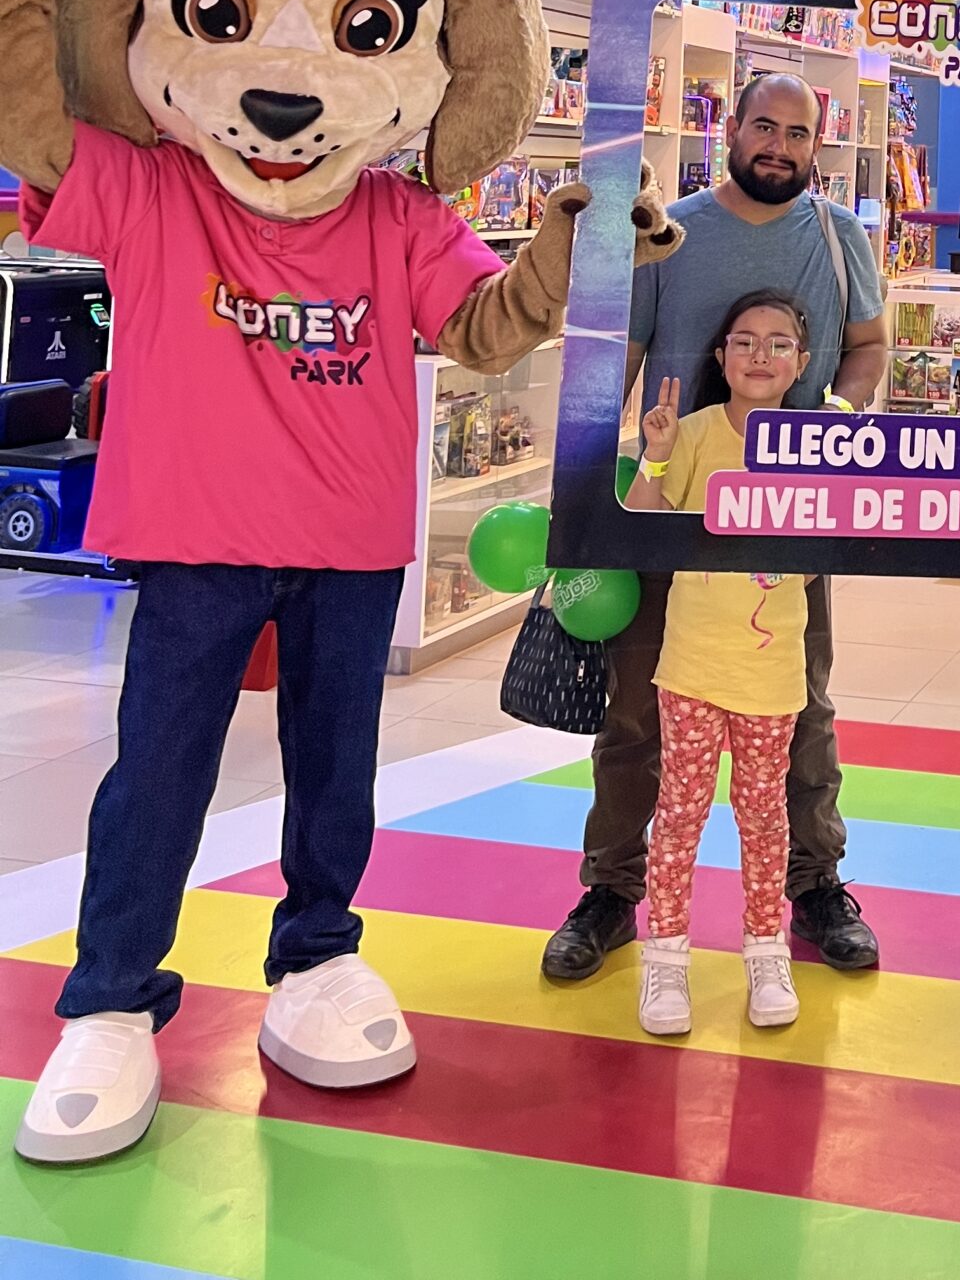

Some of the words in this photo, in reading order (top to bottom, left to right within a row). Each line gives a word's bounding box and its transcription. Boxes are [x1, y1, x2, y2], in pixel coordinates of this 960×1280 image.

[46, 351, 66, 360] ATARI
[290, 352, 371, 385] PARK
[756, 419, 886, 469] LLEGÓ
[898, 428, 957, 471] UN
[717, 485, 837, 531] NIVEL
[852, 488, 903, 532] DE
[552, 572, 597, 609] CONE
